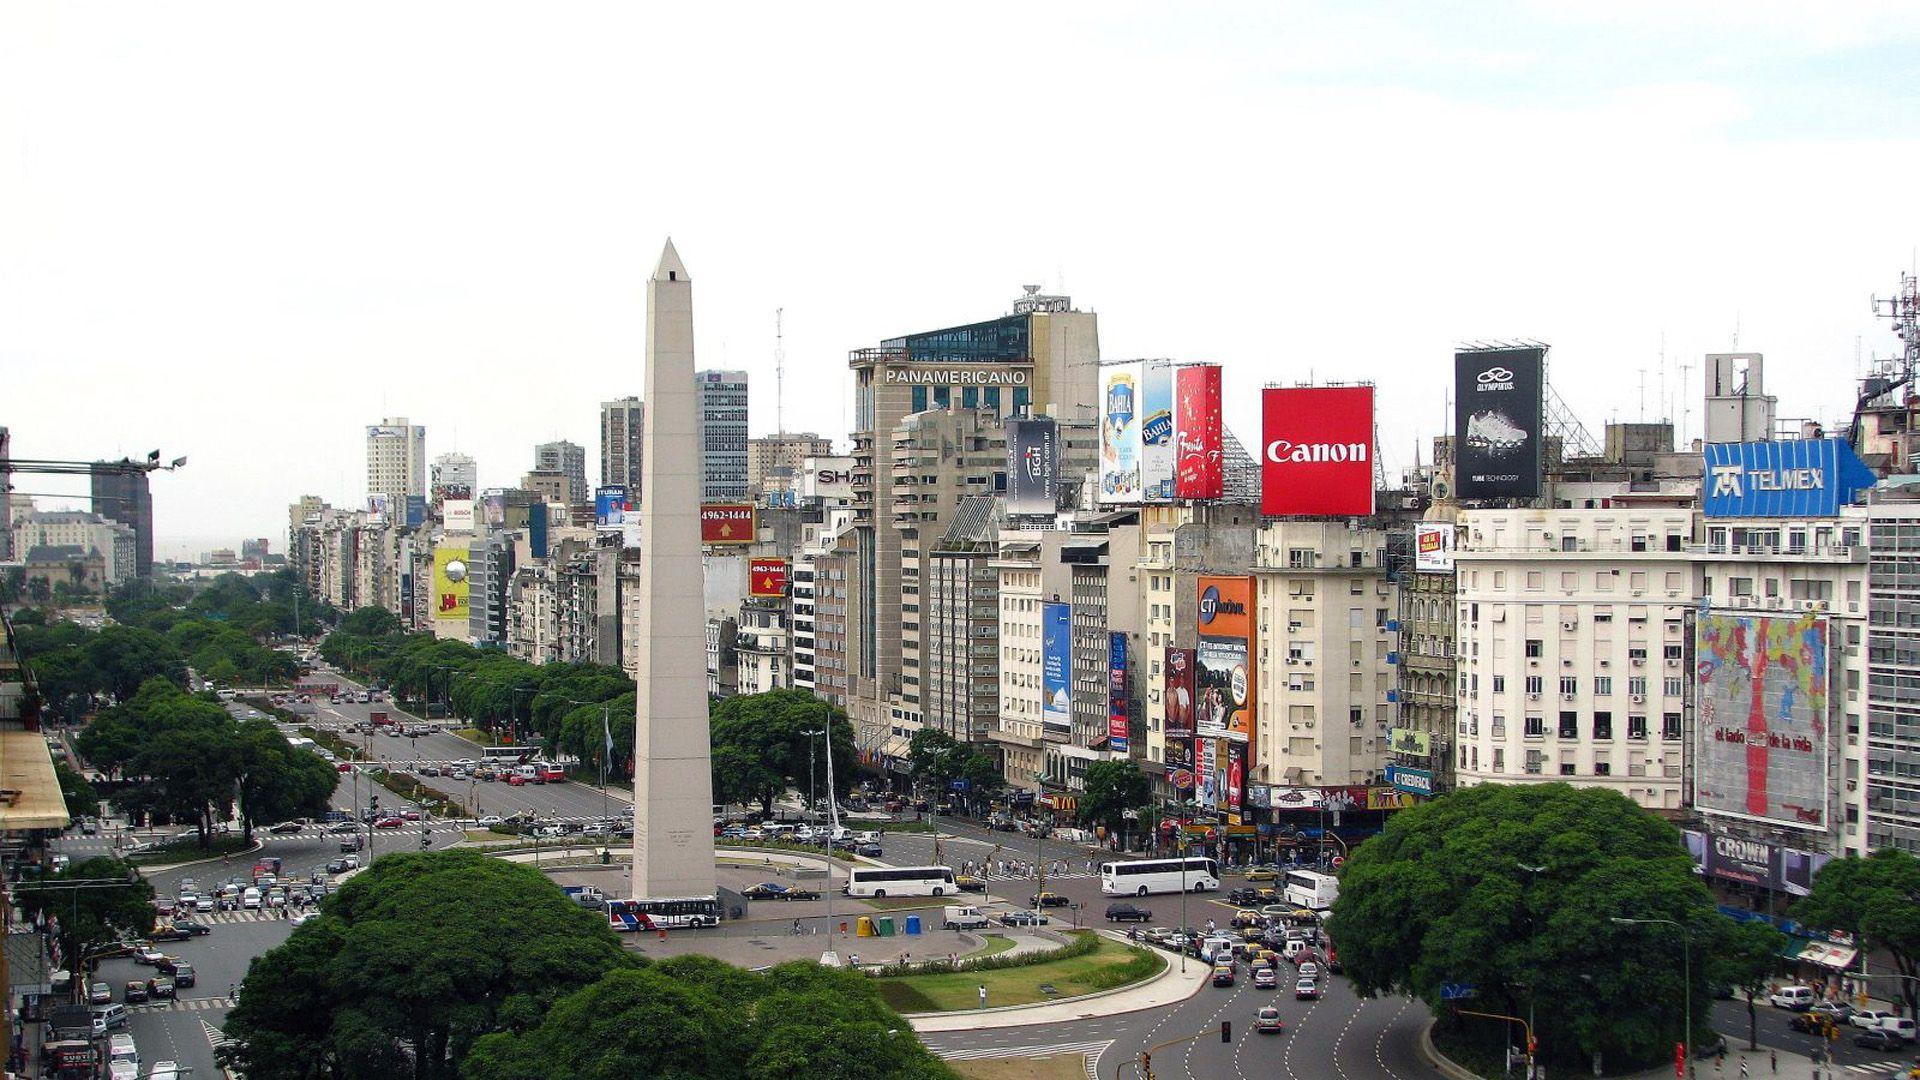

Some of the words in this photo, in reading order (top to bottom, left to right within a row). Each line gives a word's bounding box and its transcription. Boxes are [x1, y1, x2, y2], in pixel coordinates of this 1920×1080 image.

[887, 370, 1026, 384] PANAMERICANO
[1032, 447, 1041, 476] BGH
[1267, 440, 1366, 463] Canon
[1043, 431, 1051, 499] www.bgh.com.ar
[1748, 468, 1824, 490] TELMEX
[701, 510, 751, 520] 4962-1444
[752, 565, 784, 573] 4962-1444
[1715, 727, 1724, 741] el
[1793, 735, 1813, 752] vida
[1715, 837, 1769, 864] CROWN
